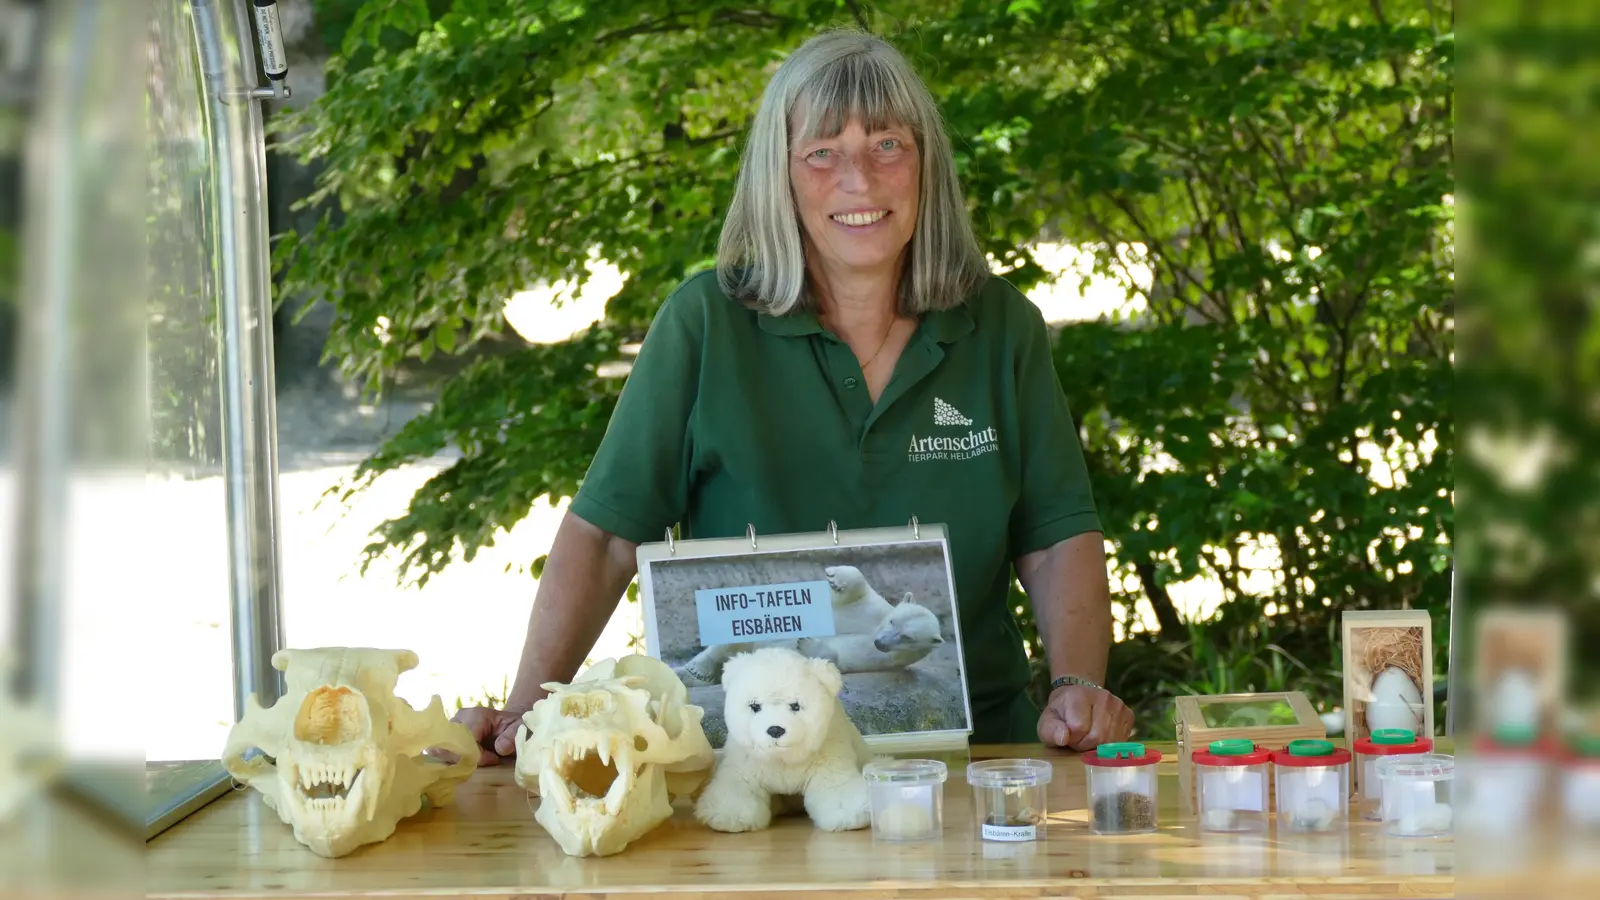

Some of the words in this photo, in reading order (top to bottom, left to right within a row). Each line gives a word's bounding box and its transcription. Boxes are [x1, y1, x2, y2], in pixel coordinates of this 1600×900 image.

[908, 452, 949, 462] TIERPARK
[715, 588, 812, 611] INFO-TAFELN
[731, 614, 802, 636] EISBÄREN
[984, 828, 1032, 837] Eisbären-Kralle
